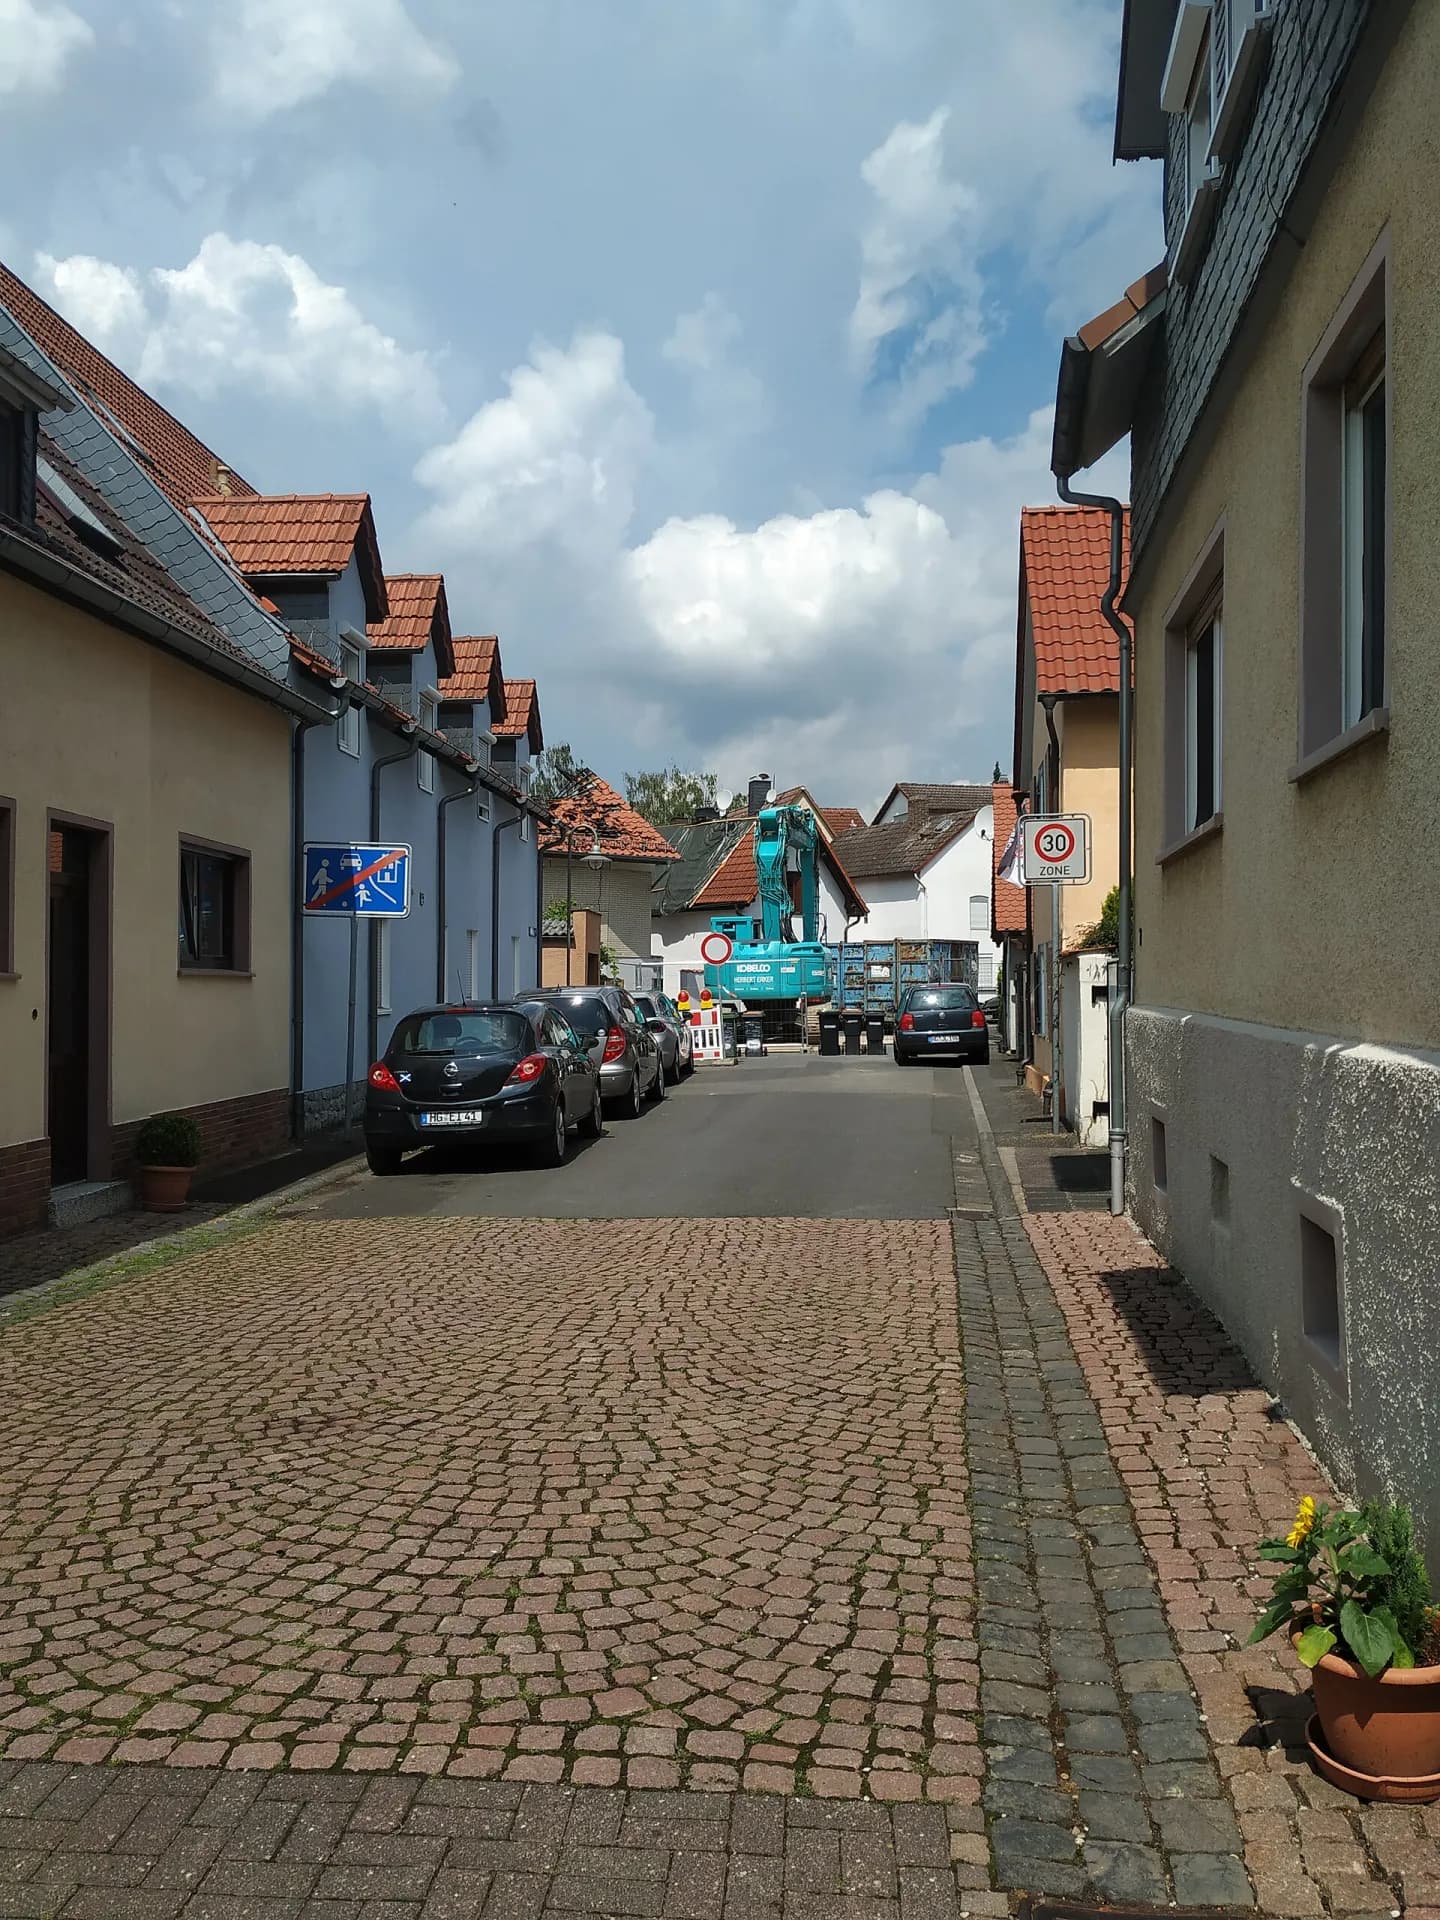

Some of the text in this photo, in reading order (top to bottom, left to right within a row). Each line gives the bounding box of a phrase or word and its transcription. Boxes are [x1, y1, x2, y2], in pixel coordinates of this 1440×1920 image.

[1043, 834, 1066, 852] 30
[1040, 866, 1070, 876] ZONE
[736, 964, 771, 973] KOBELCO
